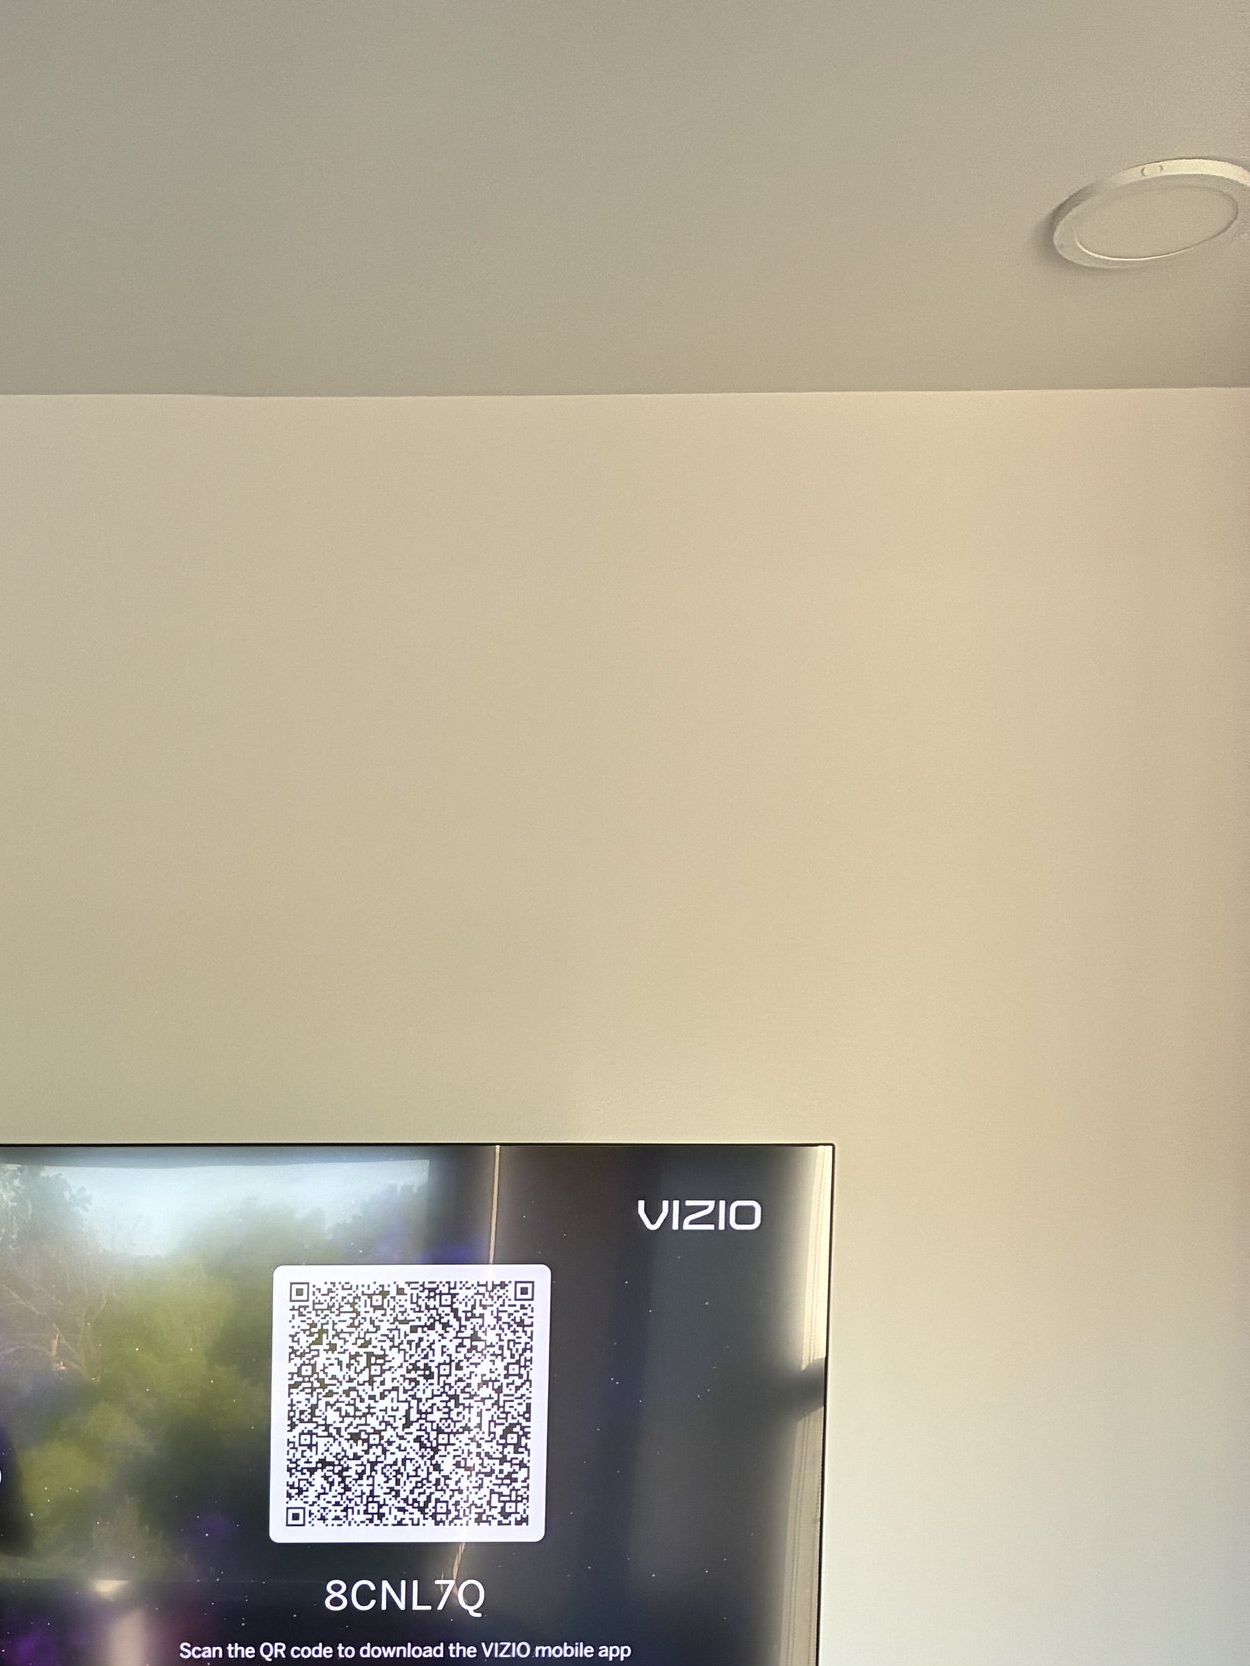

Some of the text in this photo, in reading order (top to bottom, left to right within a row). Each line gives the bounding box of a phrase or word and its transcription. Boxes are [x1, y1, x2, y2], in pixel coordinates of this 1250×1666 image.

[638, 1200, 761, 1230] VIZIO
[325, 1577, 486, 1617] 8CNL7Q
[180, 1642, 631, 1661] Scan the QR code to download the VIZIO mobile app
